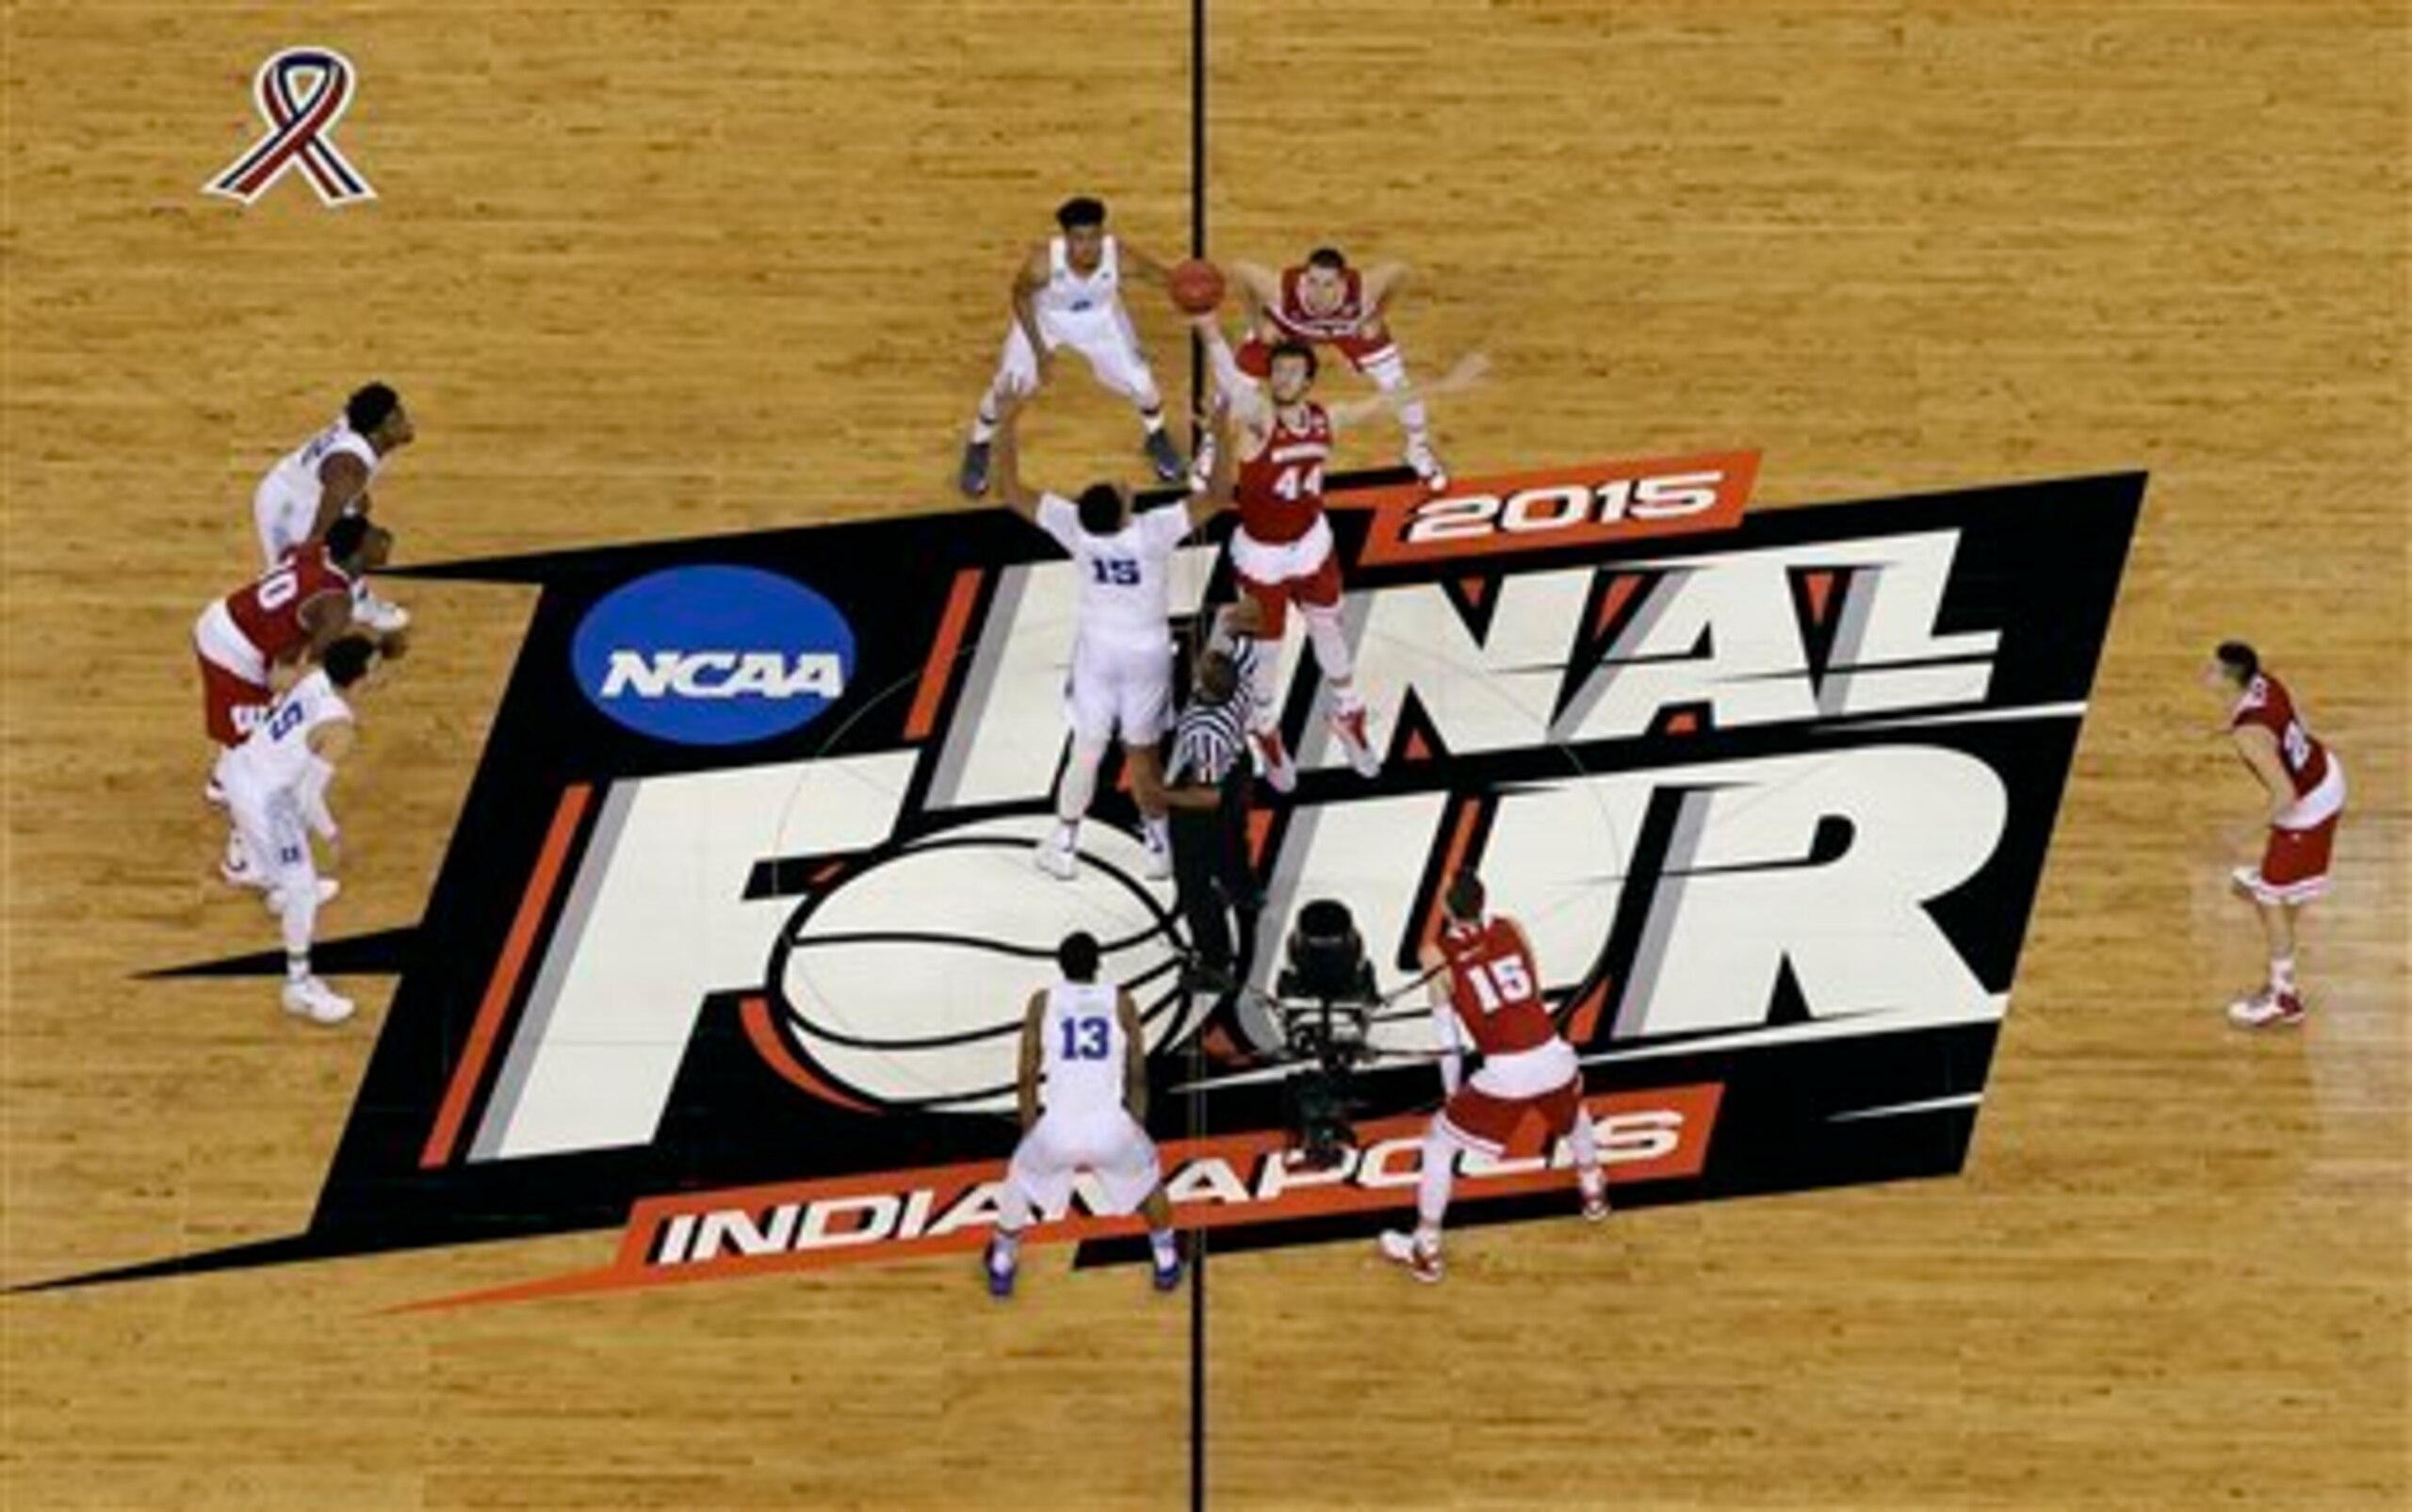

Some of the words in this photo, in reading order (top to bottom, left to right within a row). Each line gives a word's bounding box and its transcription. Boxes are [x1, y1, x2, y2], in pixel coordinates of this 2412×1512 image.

[1408, 471, 1723, 544] 2015
[1092, 559, 1141, 585] 15
[601, 650, 844, 698] NCAA
[1466, 954, 1531, 1014] 15
[1061, 1016, 1109, 1061] 13
